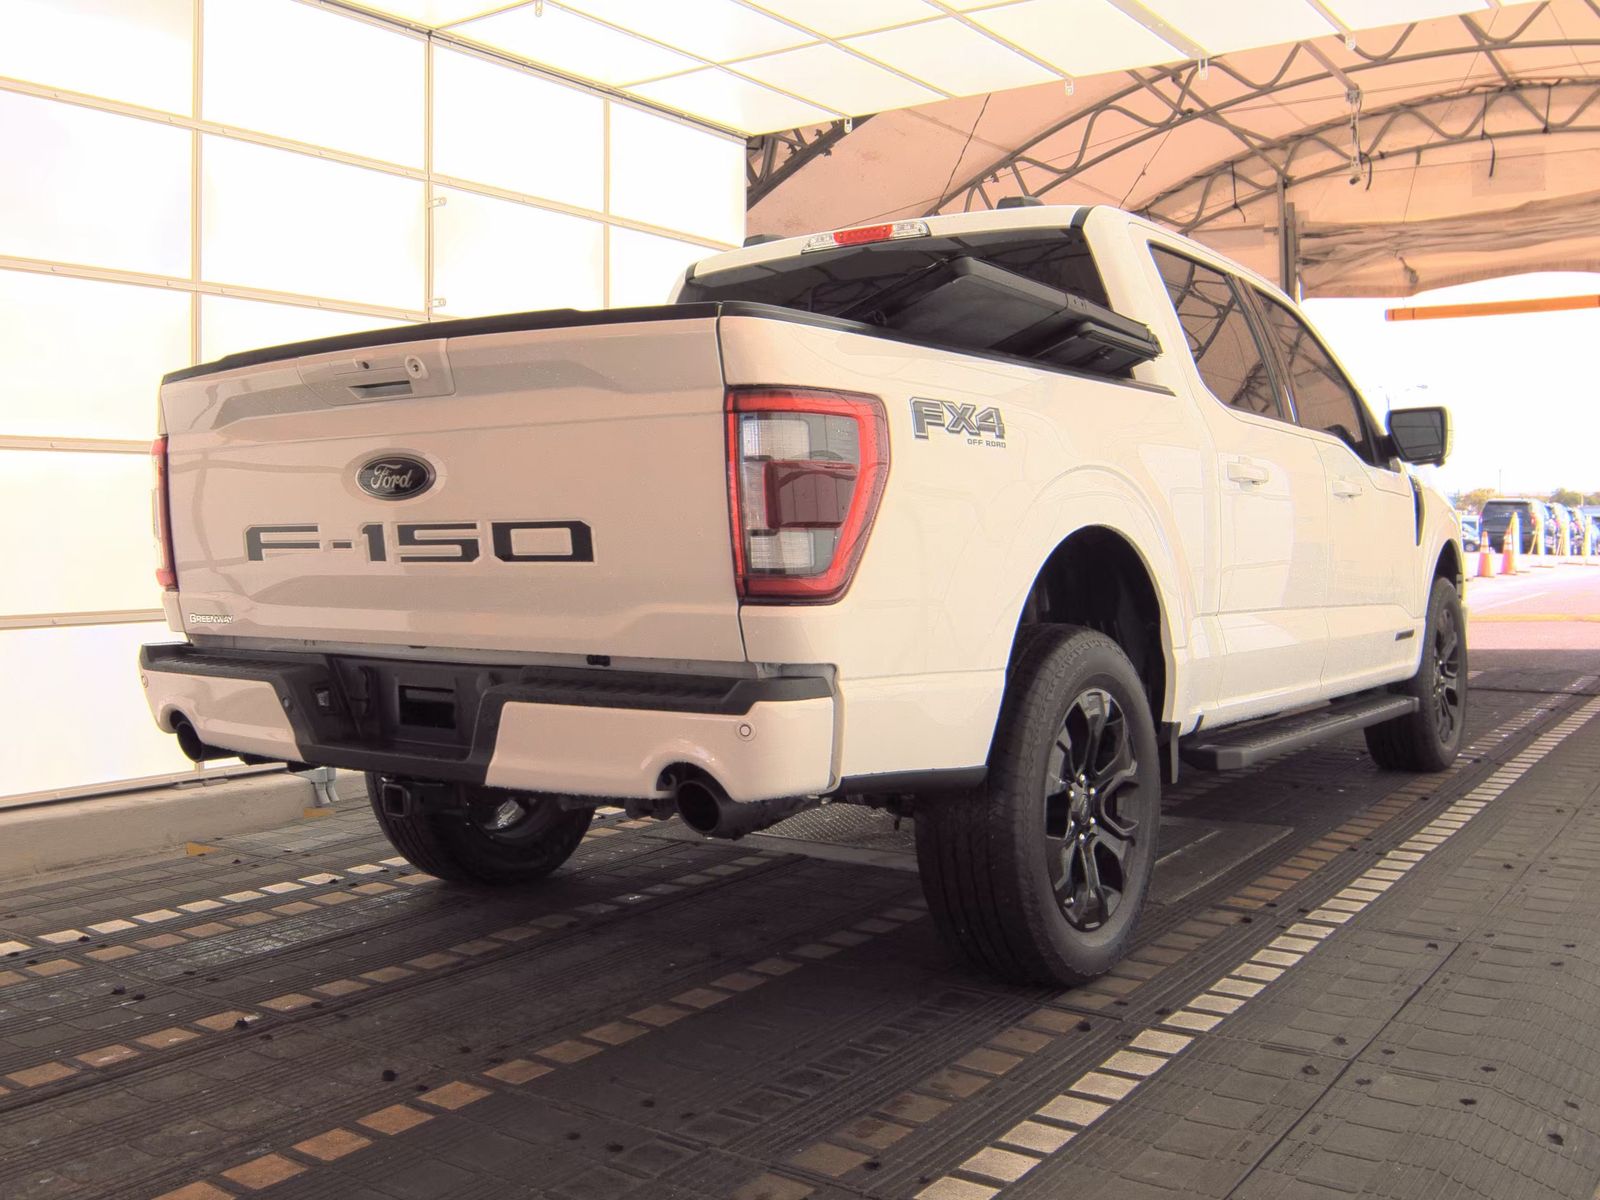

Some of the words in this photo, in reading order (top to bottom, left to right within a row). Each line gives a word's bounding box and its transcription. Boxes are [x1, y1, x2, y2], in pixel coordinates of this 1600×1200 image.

[909, 396, 1005, 440] FX4
[967, 438, 984, 447] OFF
[986, 440, 1007, 449] ROAD
[370, 463, 413, 489] Ford
[245, 520, 595, 562] F-150
